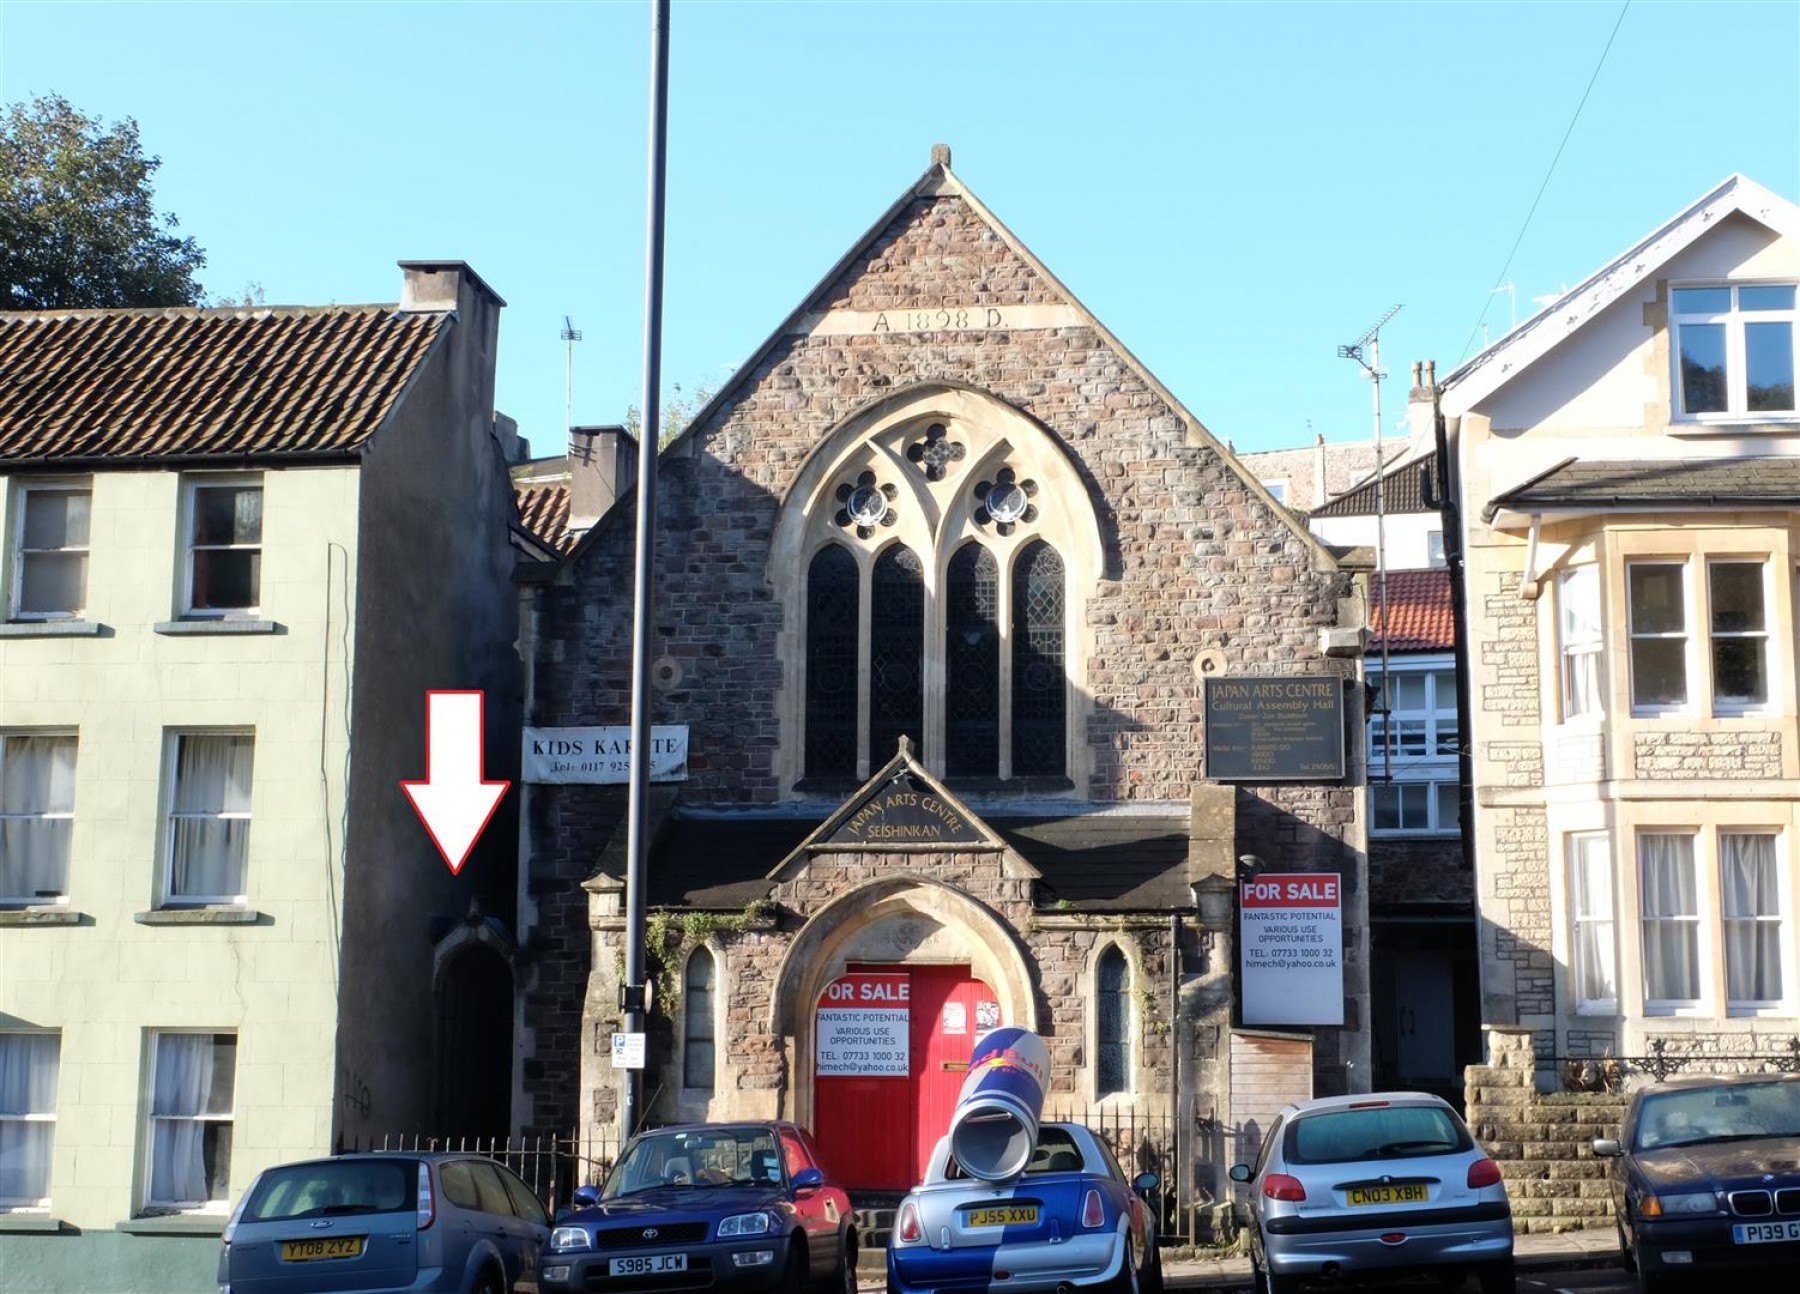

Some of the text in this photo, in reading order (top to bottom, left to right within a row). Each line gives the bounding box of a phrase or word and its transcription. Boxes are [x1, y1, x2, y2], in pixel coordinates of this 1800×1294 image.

[906, 308, 969, 331] 1898
[1212, 683, 1334, 702] JAPAN ARTS CENTRE
[1211, 699, 1334, 712] Cultural Assembly Hall
[533, 739, 583, 756] KIDS
[580, 761, 605, 772] 0117
[847, 793, 964, 836] JAPAN ARTS CENTRE
[867, 824, 941, 838] SEISHINKAN
[1243, 882, 1336, 900] FOR SALE
[1243, 912, 1336, 920] FANTASTIC POTENTIAL
[1263, 925, 1317, 933] VARIOUS USE
[1258, 934, 1324, 943] OPPORTUNITIES
[1271, 948, 1298, 958] 07733
[1300, 948, 1320, 957] 1000
[1322, 948, 1333, 957] 32
[1245, 959, 1337, 970] himech@yahoo.co.uk
[825, 983, 910, 1000] OR SALE
[817, 1013, 909, 1022] FANTASTIC POTENTIAL
[835, 1027, 890, 1036] VARIOUS USE
[829, 1037, 896, 1046] OPPORTUNITIES
[843, 1051, 870, 1060] 07733
[872, 1051, 892, 1060] 1000
[894, 1051, 906, 1060] 32
[817, 1062, 909, 1073] himech@yahoo.co.uk
[1350, 1186, 1424, 1203] CN03 XBH
[969, 1207, 1036, 1225] PJ55 XXU
[1746, 1224, 1785, 1241] P139
[288, 1239, 355, 1257] YT08 ZYZ
[616, 1254, 684, 1274] S985 JCW
